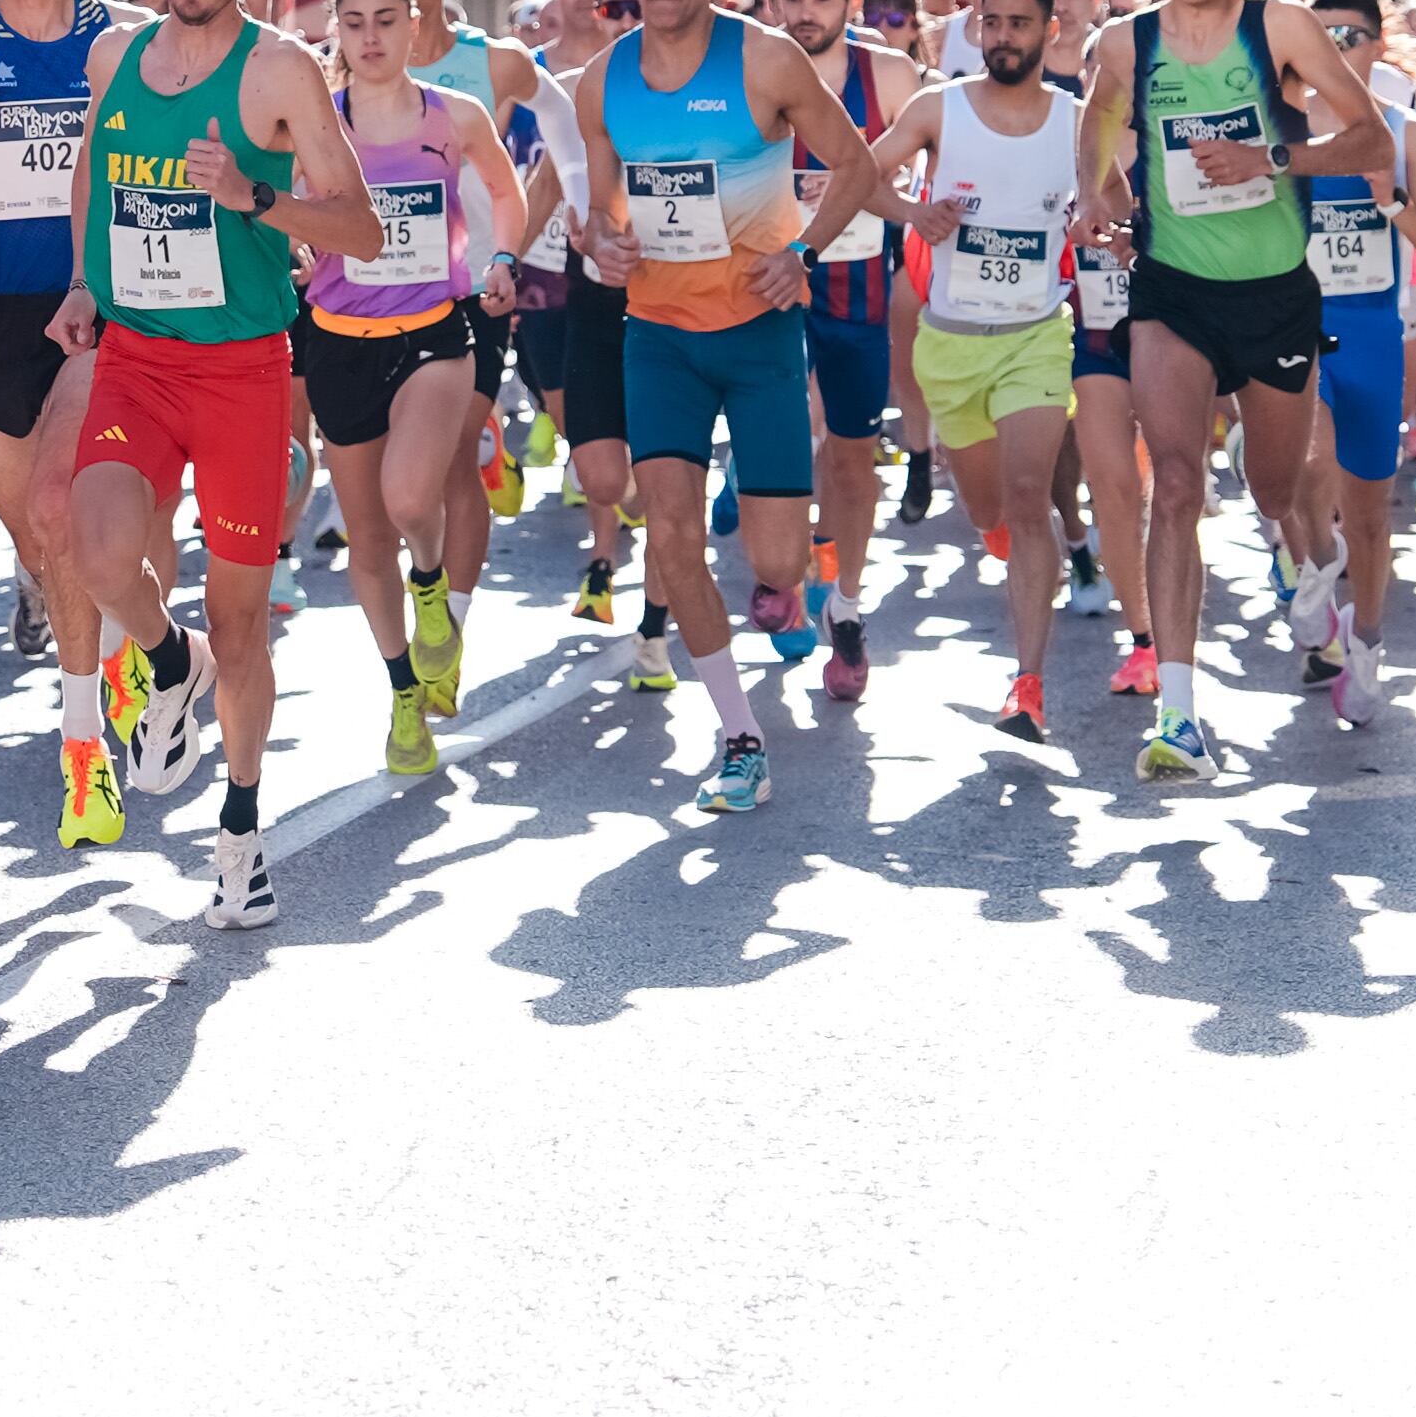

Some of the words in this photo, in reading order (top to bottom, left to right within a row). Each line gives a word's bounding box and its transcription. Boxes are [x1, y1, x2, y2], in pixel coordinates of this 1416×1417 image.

[0, 105, 38, 117] CURSA
[687, 99, 727, 112] HOKA
[24, 125, 65, 138] IBIZA
[1173, 116, 1248, 139] PATRIMONI
[22, 142, 73, 172] 402
[108, 152, 205, 189] BIKIL
[636, 171, 704, 185] PATRIMONI
[123, 199, 198, 217] PATRIMONI
[664, 200, 679, 224] 2
[137, 214, 173, 229] IBIZA
[383, 221, 410, 246] 15
[143, 233, 169, 263] 11
[1323, 234, 1364, 259] 164
[980, 260, 1020, 284] 538
[216, 515, 259, 536] BIKILA
